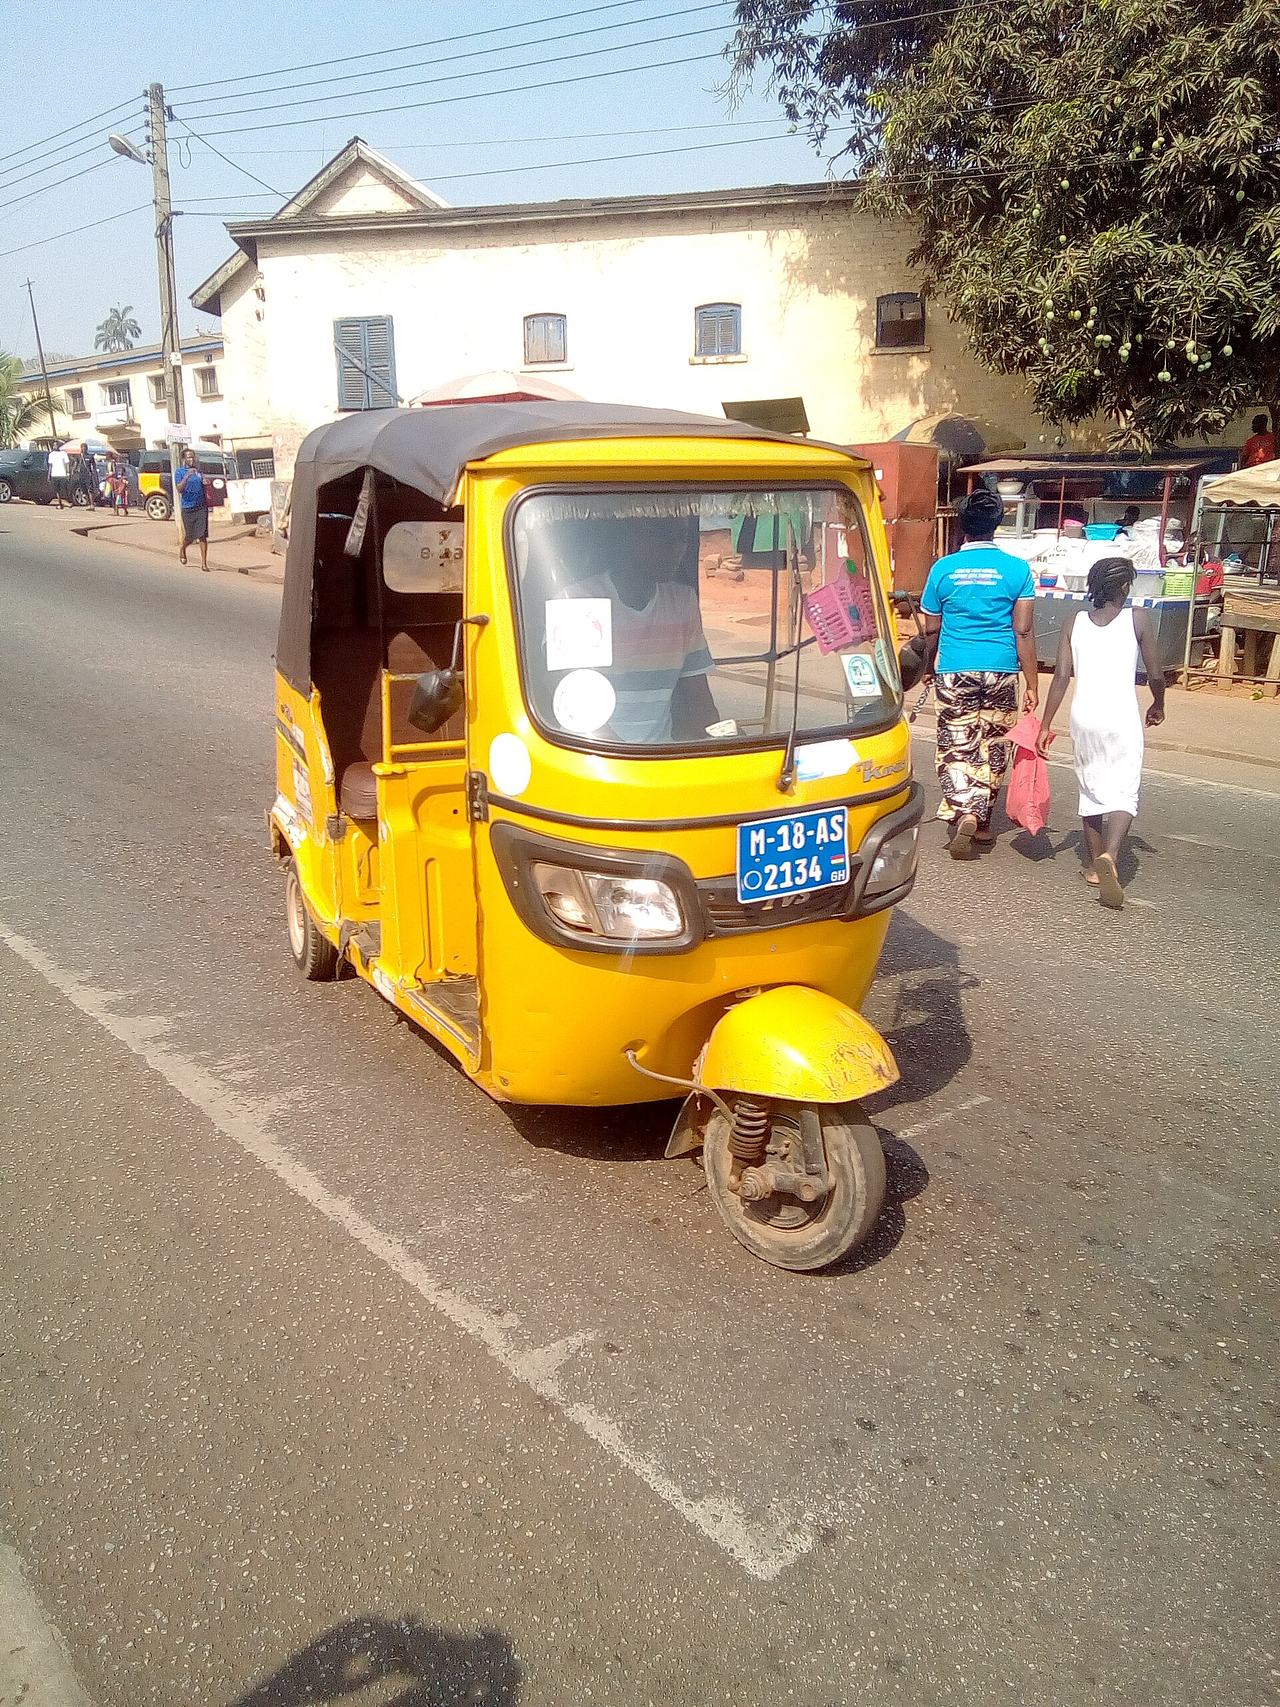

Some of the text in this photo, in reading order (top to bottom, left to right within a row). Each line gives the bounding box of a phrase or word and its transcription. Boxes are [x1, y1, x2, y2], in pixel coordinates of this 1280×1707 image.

[750, 815, 844, 857] M-18-AS
[764, 856, 822, 891] 2134
[830, 869, 846, 882] GH
